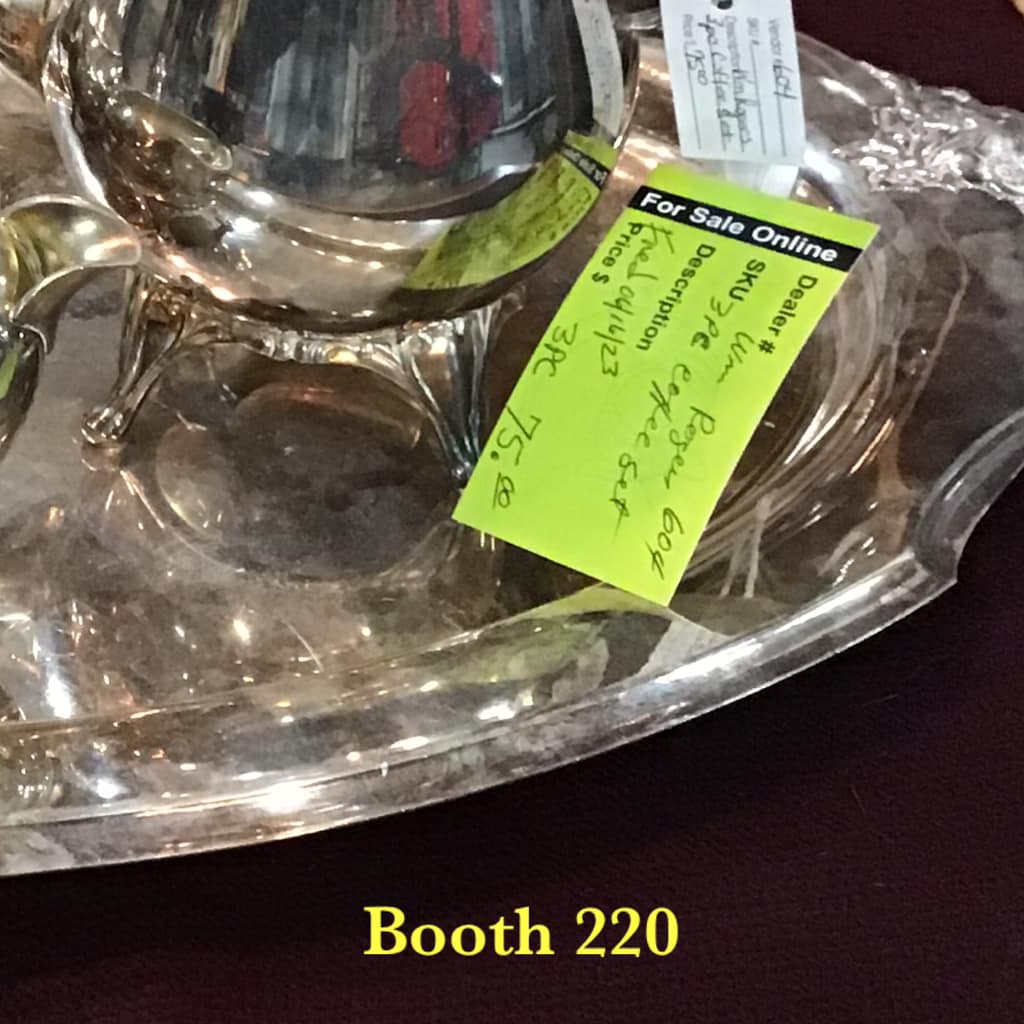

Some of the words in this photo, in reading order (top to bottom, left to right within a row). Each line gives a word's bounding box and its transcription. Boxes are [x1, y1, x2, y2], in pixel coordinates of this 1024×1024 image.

[601, 221, 644, 267] Price
[640, 192, 686, 217] For
[689, 207, 745, 235] Sale
[751, 226, 839, 263] Online
[635, 243, 716, 351] Description
[729, 258, 767, 302] SKU
[768, 274, 819, 337] Dealer
[758, 339, 776, 354] #
[645, 507, 685, 580] 604
